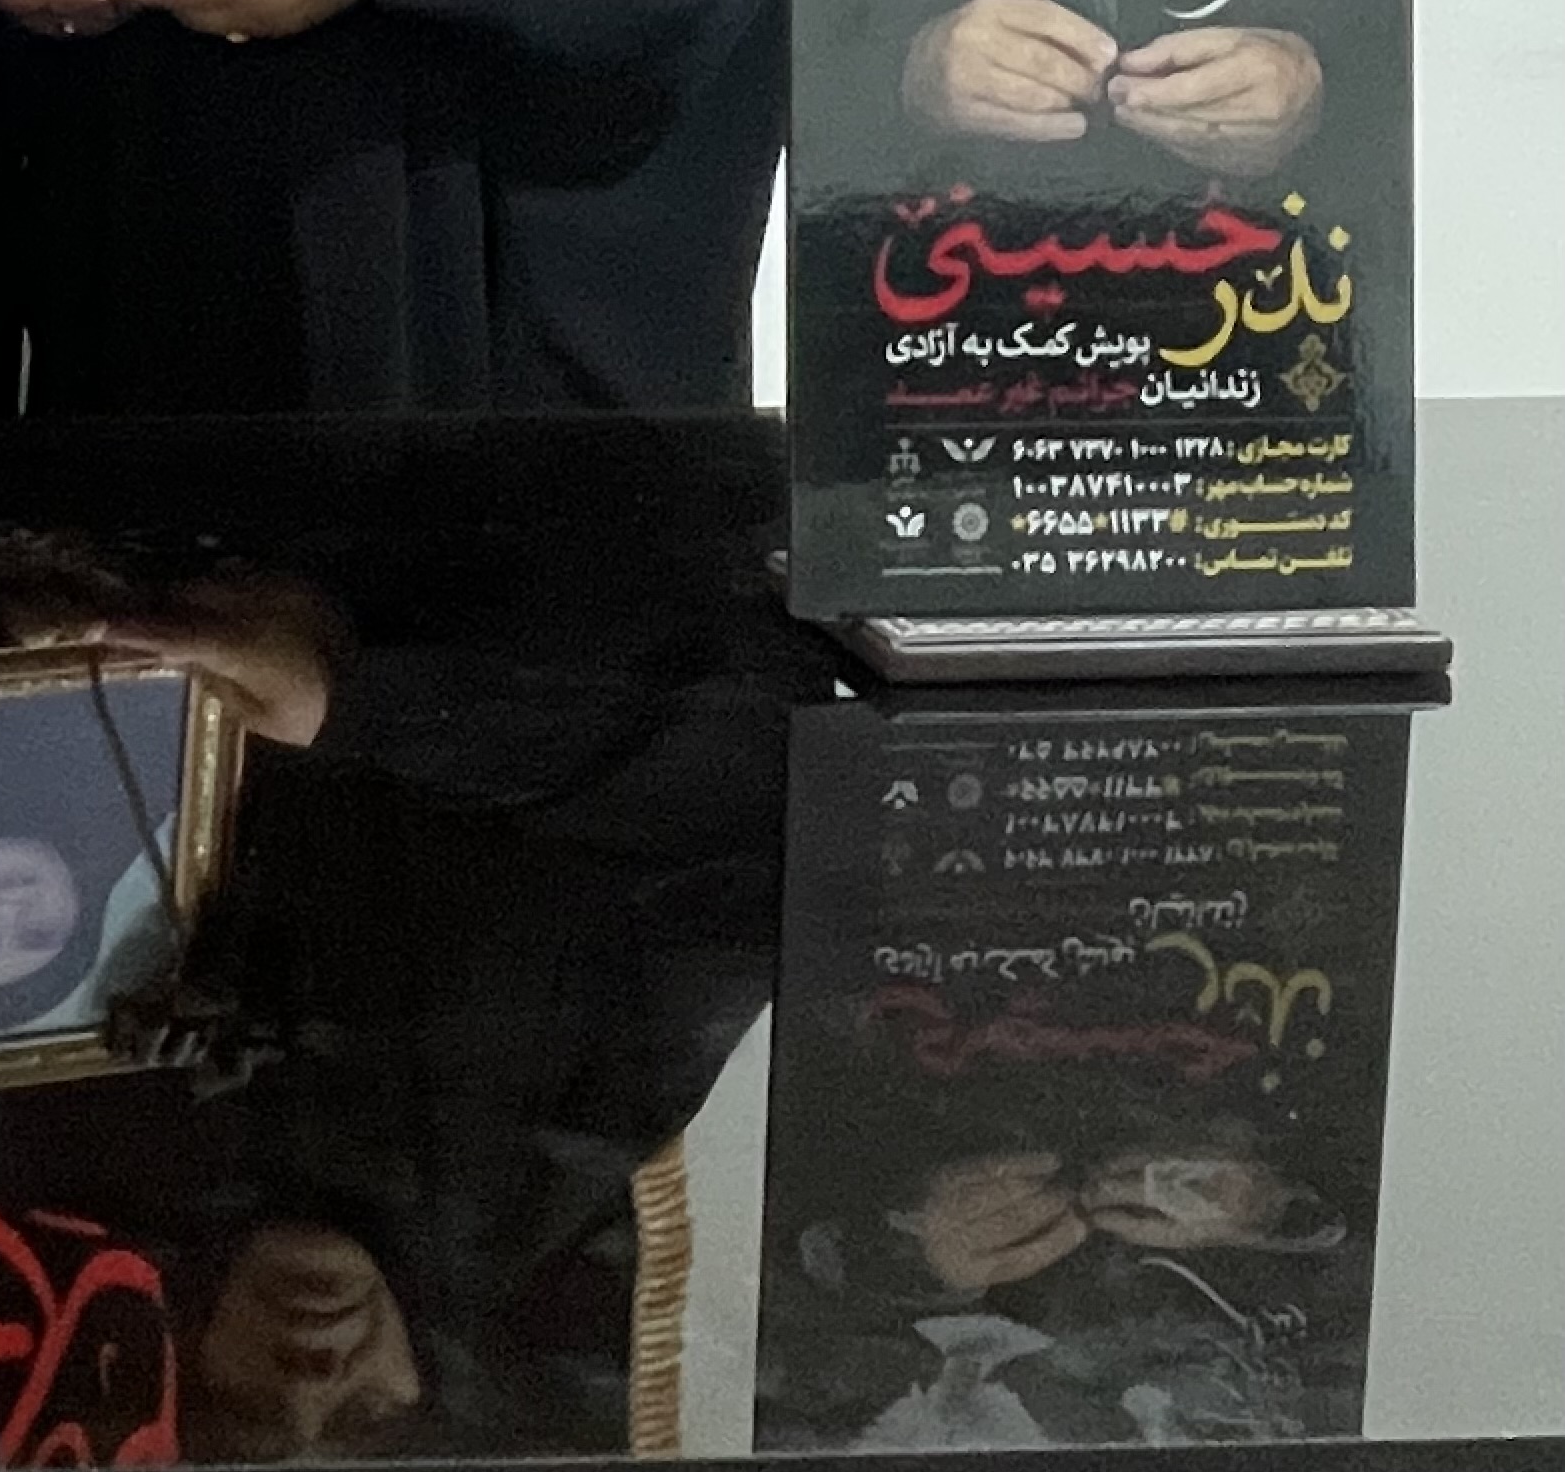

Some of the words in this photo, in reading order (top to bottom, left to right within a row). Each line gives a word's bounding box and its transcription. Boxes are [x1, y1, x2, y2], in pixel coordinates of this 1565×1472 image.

[872, 183, 1284, 326] حسینی
[1157, 190, 1353, 368] نذر
[884, 322, 959, 367] آزادی
[960, 332, 994, 369] به
[996, 322, 1077, 358] کمک
[1139, 369, 1263, 410] زندانیان
